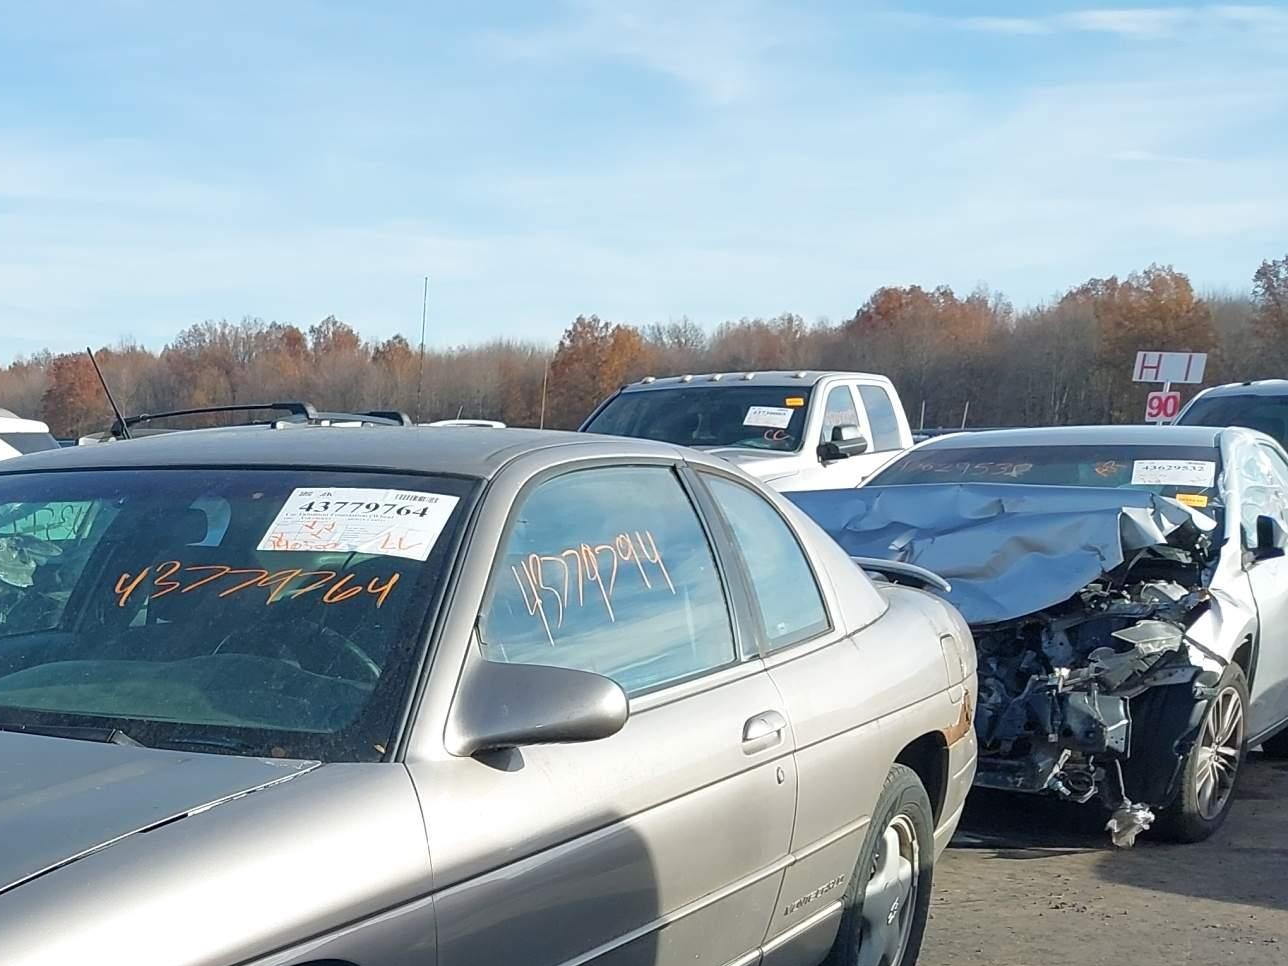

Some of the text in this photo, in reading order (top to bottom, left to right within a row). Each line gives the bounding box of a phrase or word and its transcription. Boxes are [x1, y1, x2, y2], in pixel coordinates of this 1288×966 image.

[1147, 395, 1178, 418] 90
[298, 501, 429, 518] 43779764
[114, 559, 401, 608] 43779764
